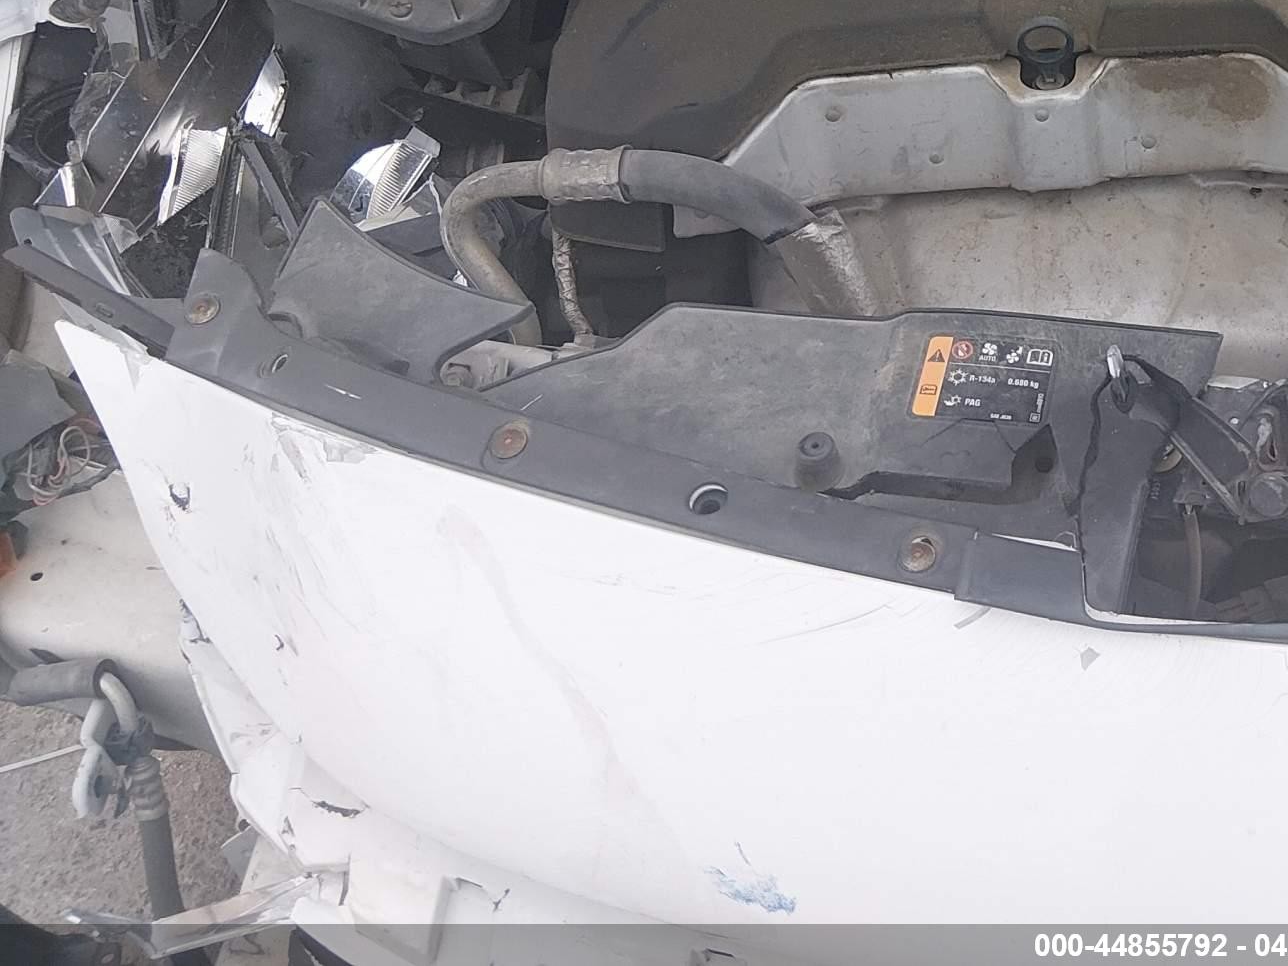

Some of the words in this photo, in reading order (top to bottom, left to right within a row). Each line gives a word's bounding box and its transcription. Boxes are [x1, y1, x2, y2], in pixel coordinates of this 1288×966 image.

[969, 374, 996, 384] R-134a
[1030, 380, 1039, 389] kg
[964, 398, 981, 407] PAG
